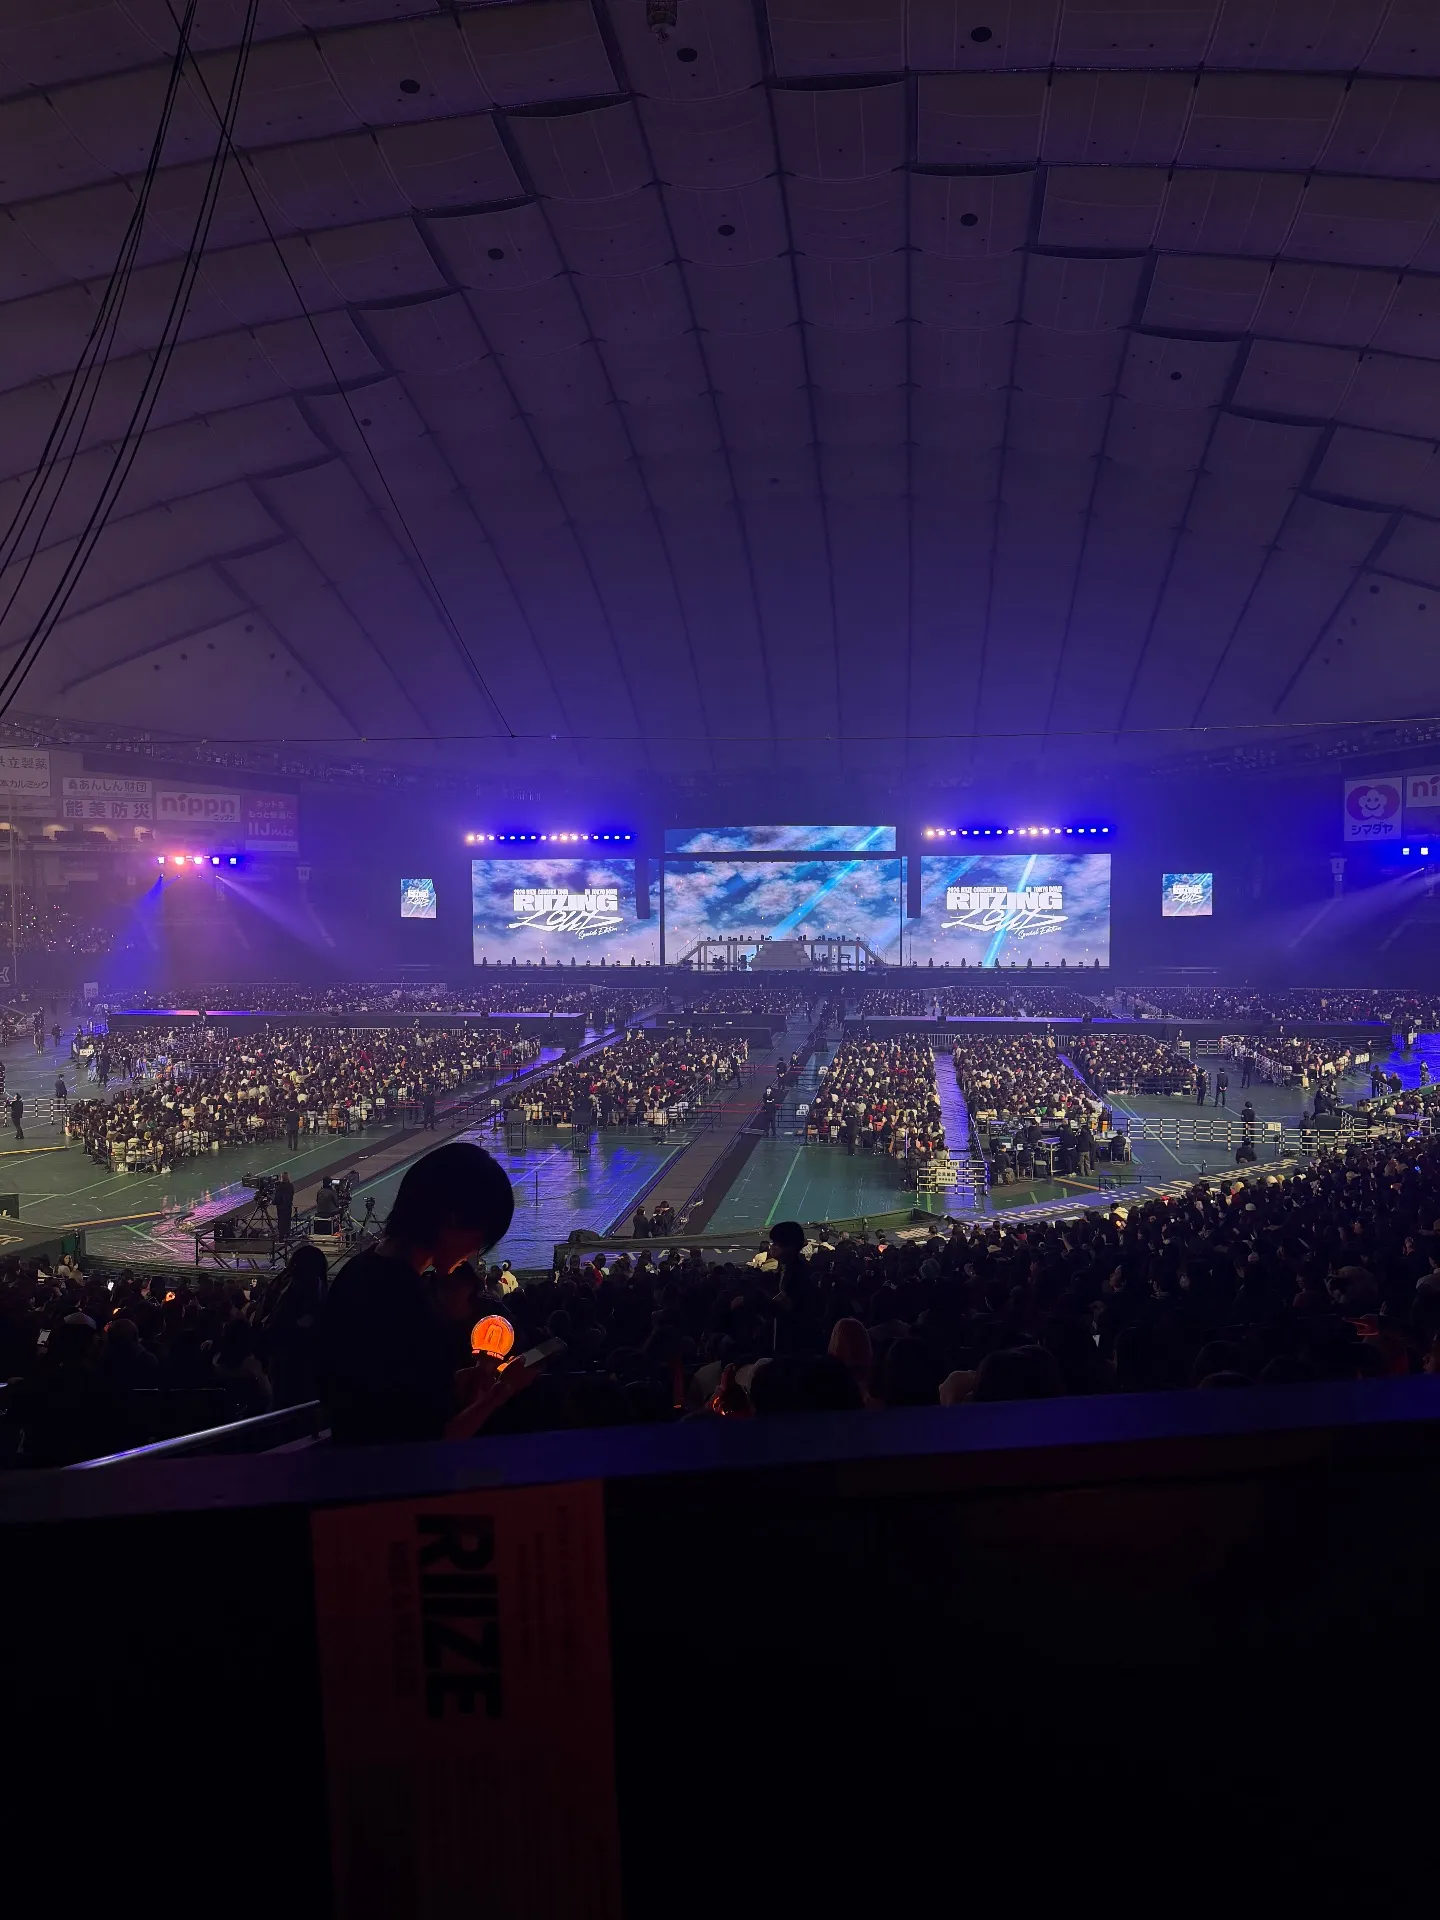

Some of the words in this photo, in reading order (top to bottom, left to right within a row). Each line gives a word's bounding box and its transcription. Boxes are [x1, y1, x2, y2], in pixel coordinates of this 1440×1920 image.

[79, 780, 147, 793] あんしん財団
[66, 799, 151, 819] 能美防災
[162, 794, 235, 817] nippn
[1351, 821, 1393, 835] シマダヤ
[416, 1514, 503, 1720] RIIZE
